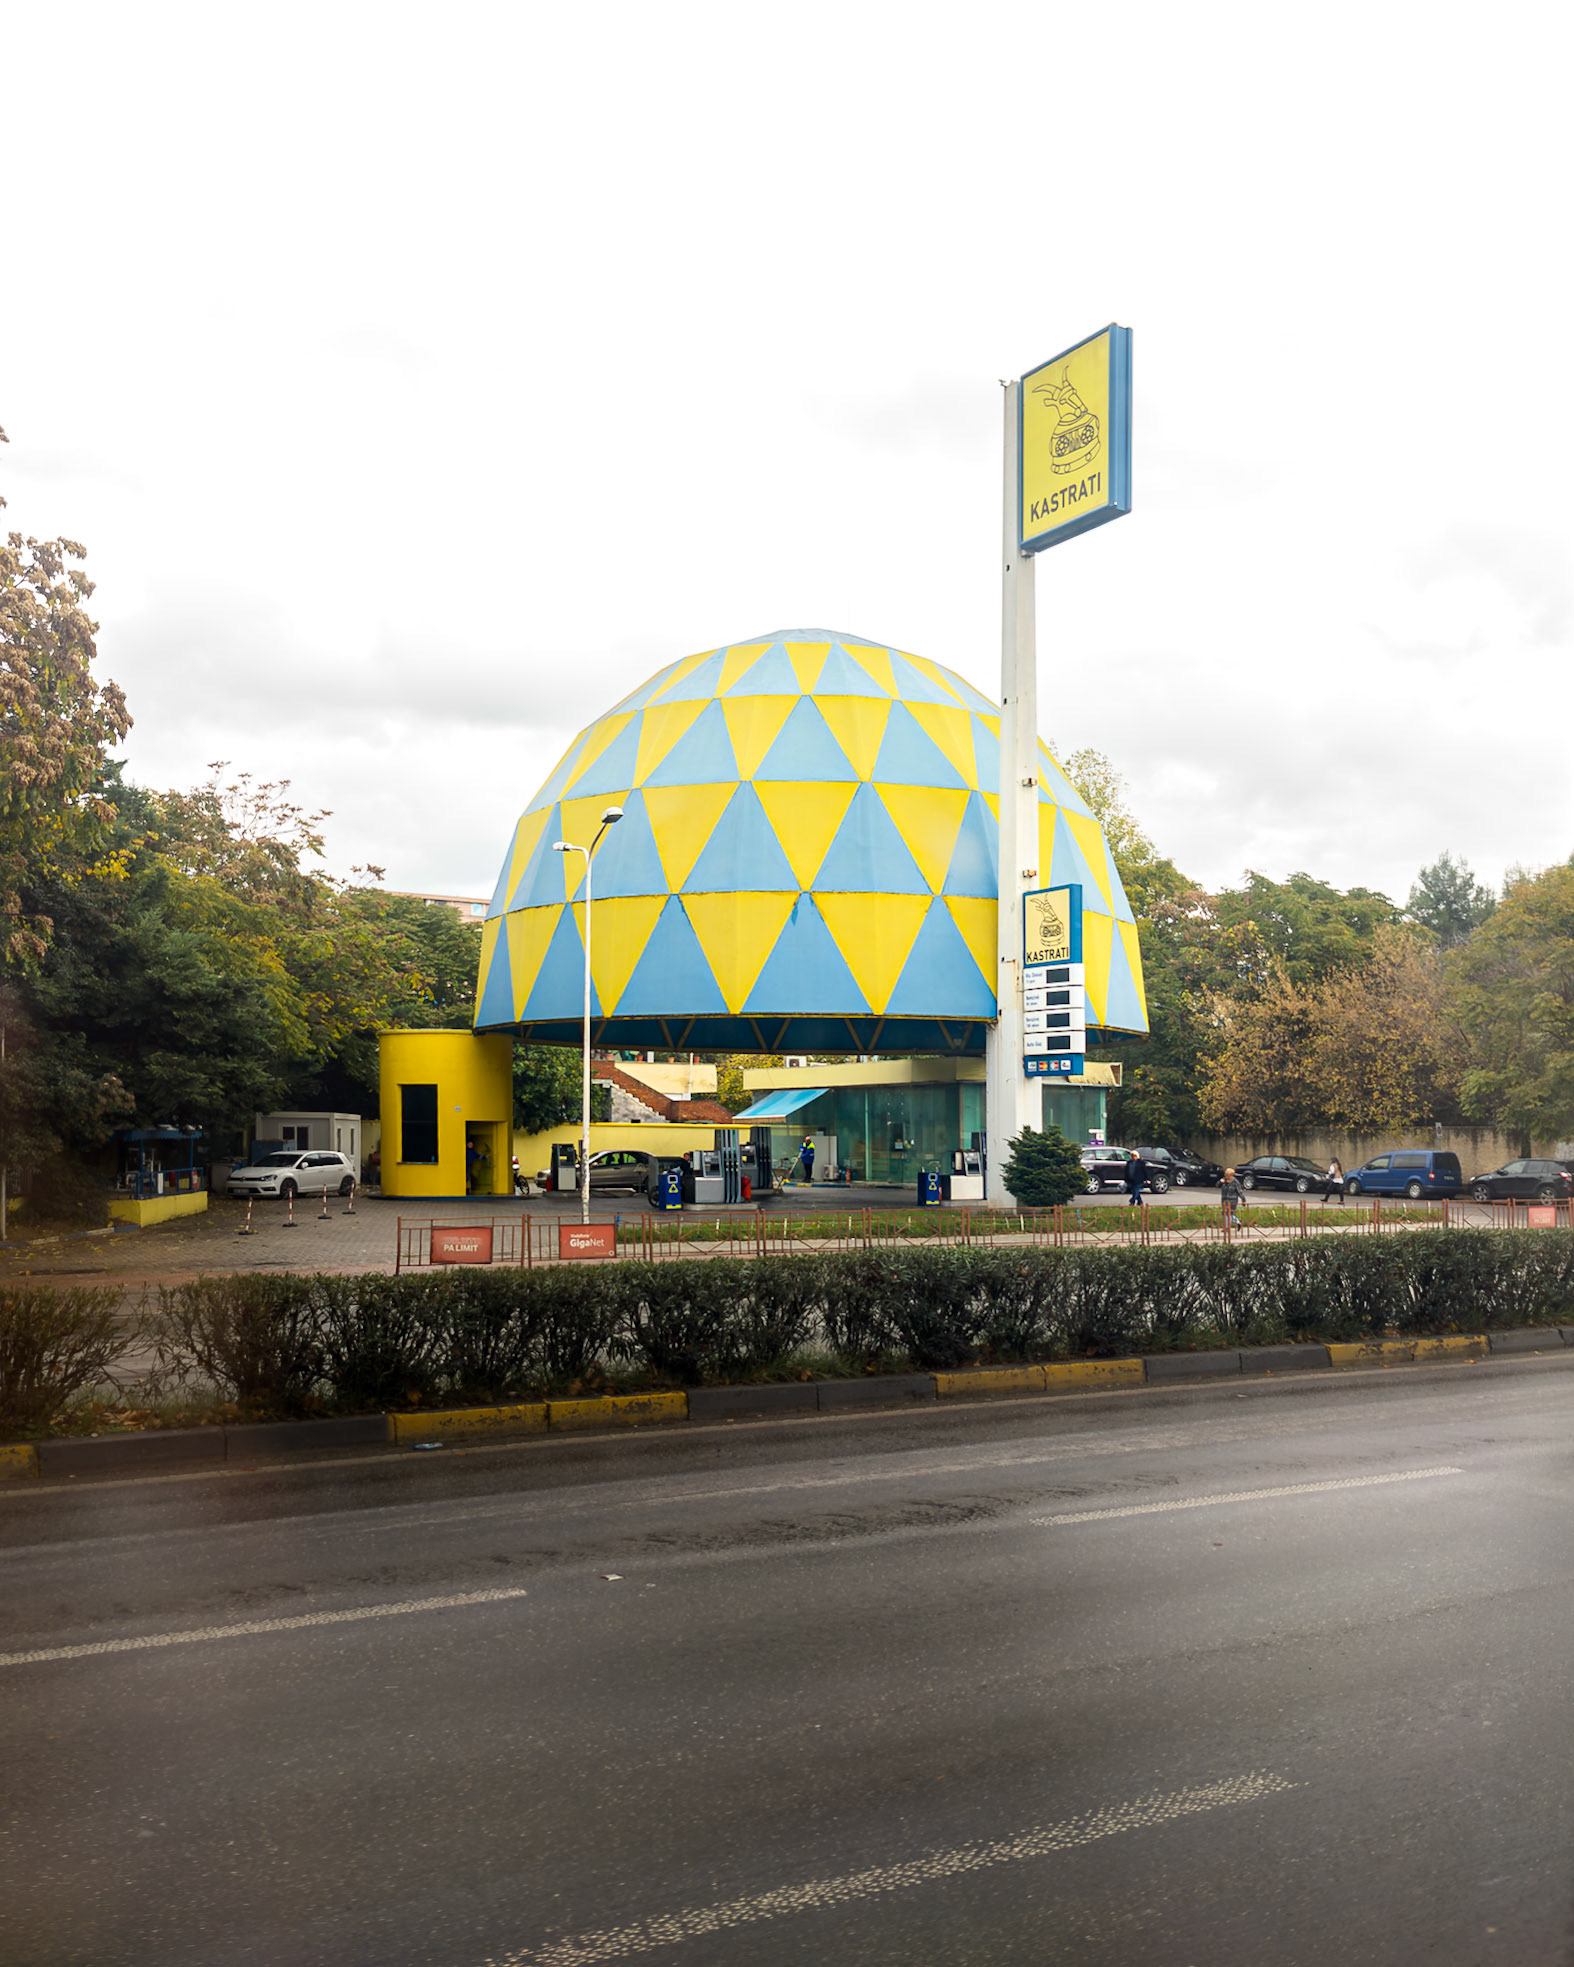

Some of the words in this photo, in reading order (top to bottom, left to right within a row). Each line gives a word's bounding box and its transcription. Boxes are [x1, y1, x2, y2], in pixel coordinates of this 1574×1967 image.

[1030, 471, 1101, 523] KASTRATI
[1026, 946, 1069, 963] KASTRATI
[443, 1243, 454, 1252] PA
[455, 1243, 479, 1252] LIMIT
[569, 1238, 605, 1249] GigaNet
